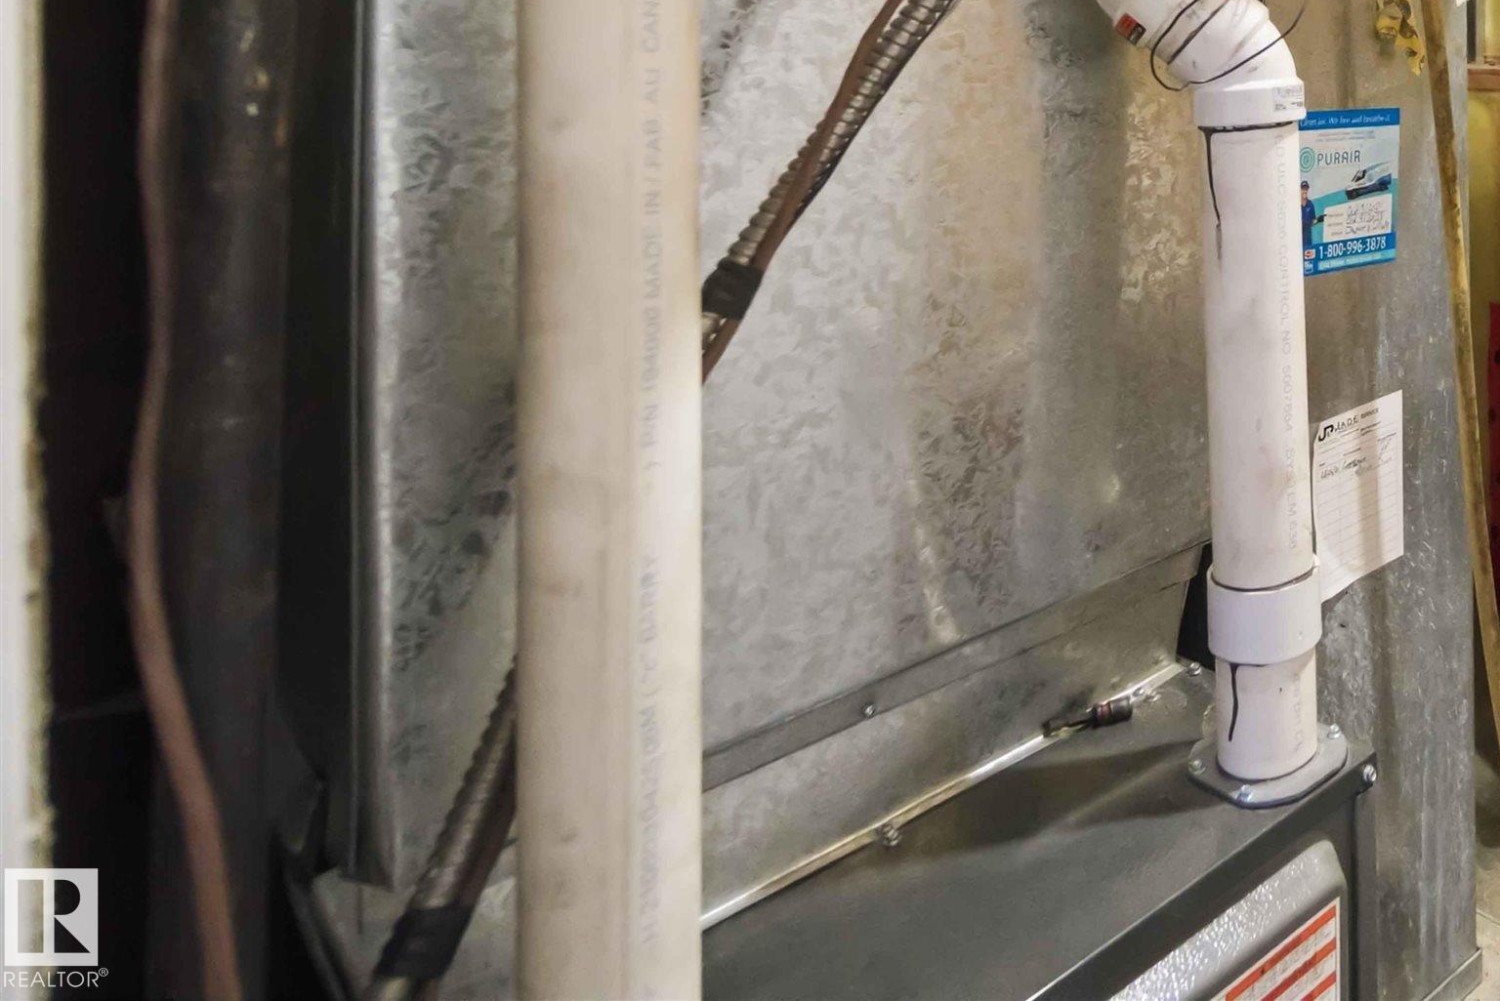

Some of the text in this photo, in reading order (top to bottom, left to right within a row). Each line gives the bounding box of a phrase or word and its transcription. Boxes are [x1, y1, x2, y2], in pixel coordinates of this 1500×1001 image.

[1317, 149, 1361, 168] PURAIR
[642, 189, 661, 215] IN
[1318, 235, 1387, 260] 1-800-996-3878
[642, 227, 662, 299] MADE
